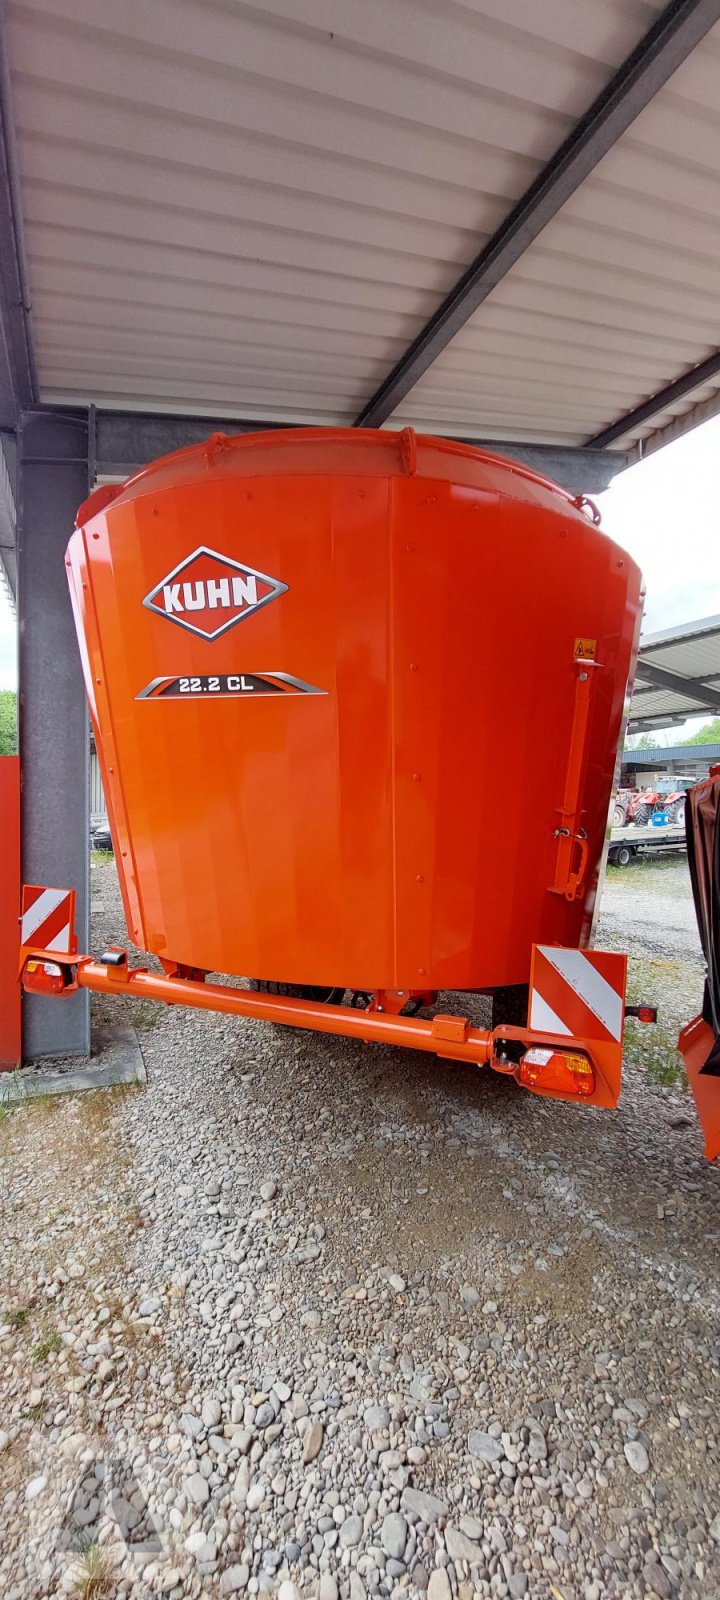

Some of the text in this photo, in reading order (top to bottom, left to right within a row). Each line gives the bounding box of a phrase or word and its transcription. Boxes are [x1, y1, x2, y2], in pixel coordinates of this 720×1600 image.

[163, 575, 258, 613] KUHN
[179, 676, 254, 692] 22.2 CL
